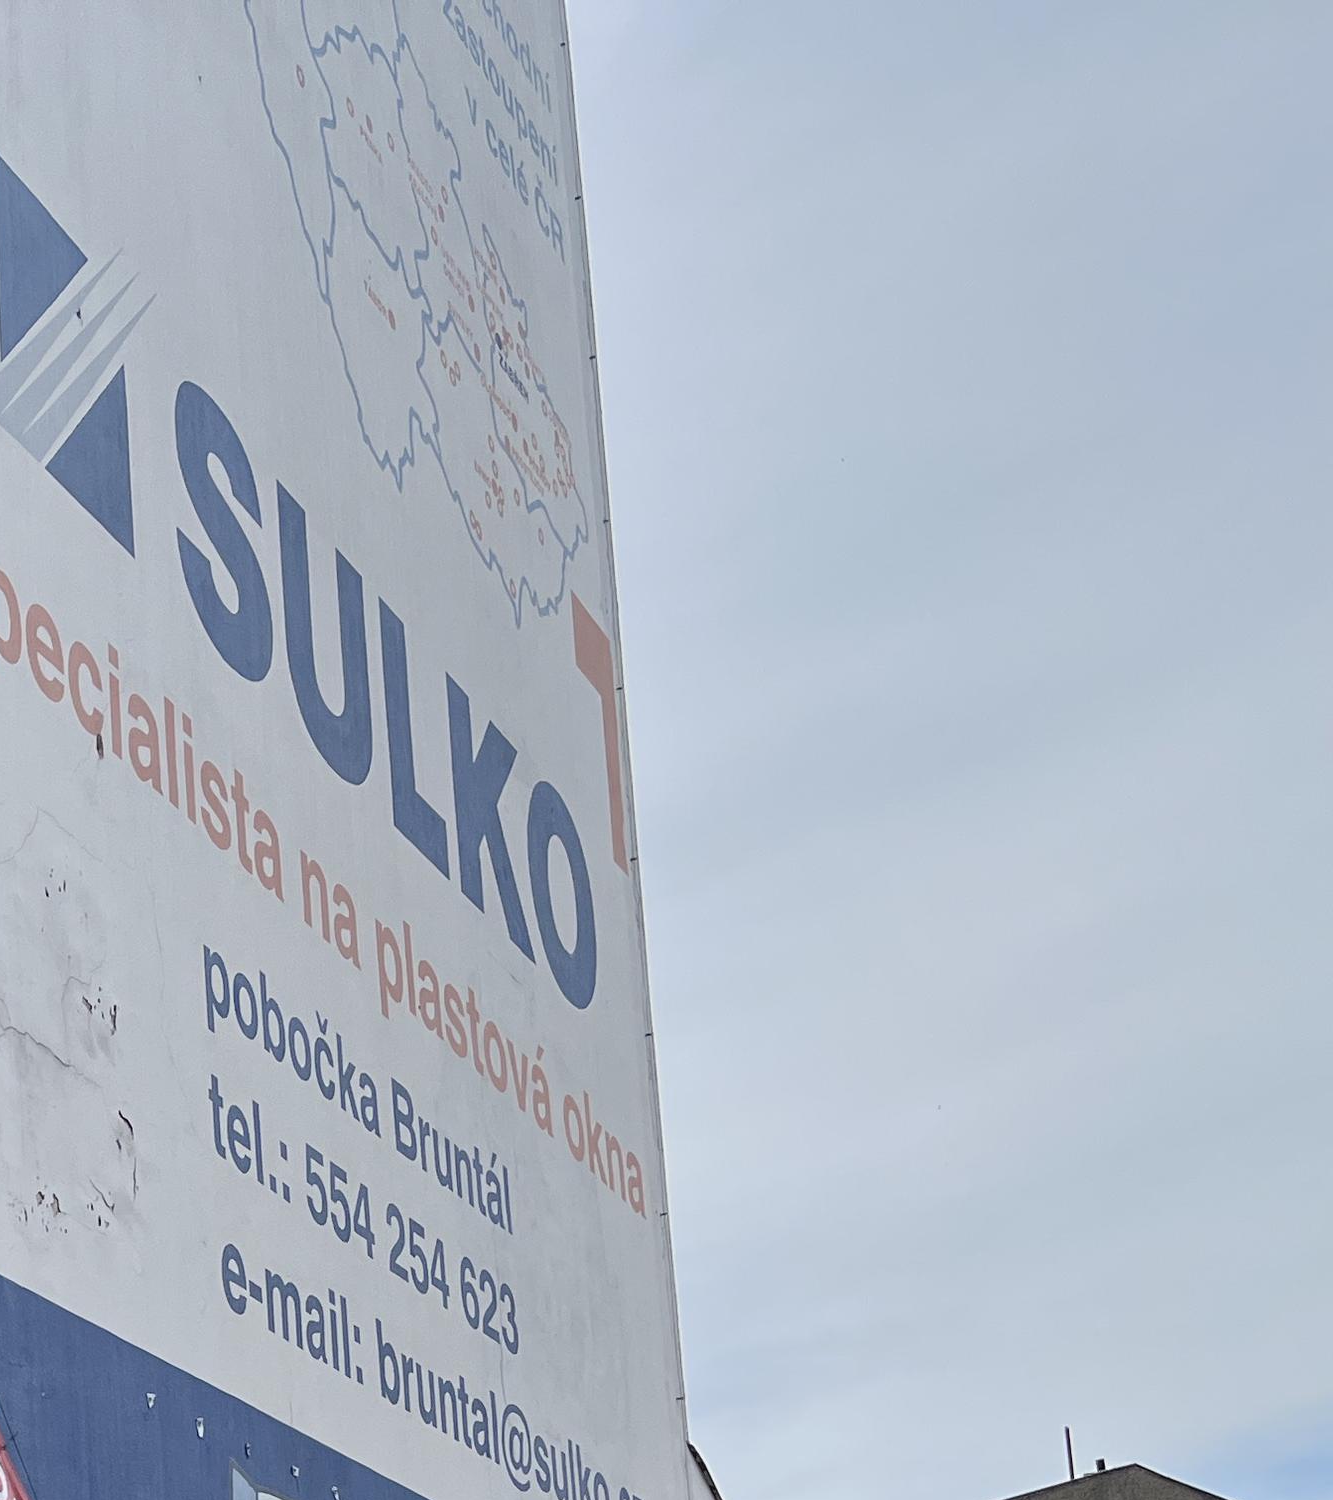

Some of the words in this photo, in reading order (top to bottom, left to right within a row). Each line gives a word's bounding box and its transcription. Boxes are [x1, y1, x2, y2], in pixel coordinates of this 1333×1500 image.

[485, 118, 529, 207] celé
[534, 173, 565, 266] ČR
[174, 380, 597, 1010] SULKO
[203, 943, 381, 1138] pobočka
[391, 1075, 513, 1235] Bruntál
[298, 848, 361, 970] na
[375, 917, 554, 1138] plastová
[564, 1090, 648, 1220] okna
[207, 1074, 292, 1203] tel.:
[306, 1145, 376, 1261] 554
[388, 1204, 450, 1312] 254
[460, 1256, 520, 1357] 623
[222, 1242, 365, 1386] e-mail:
